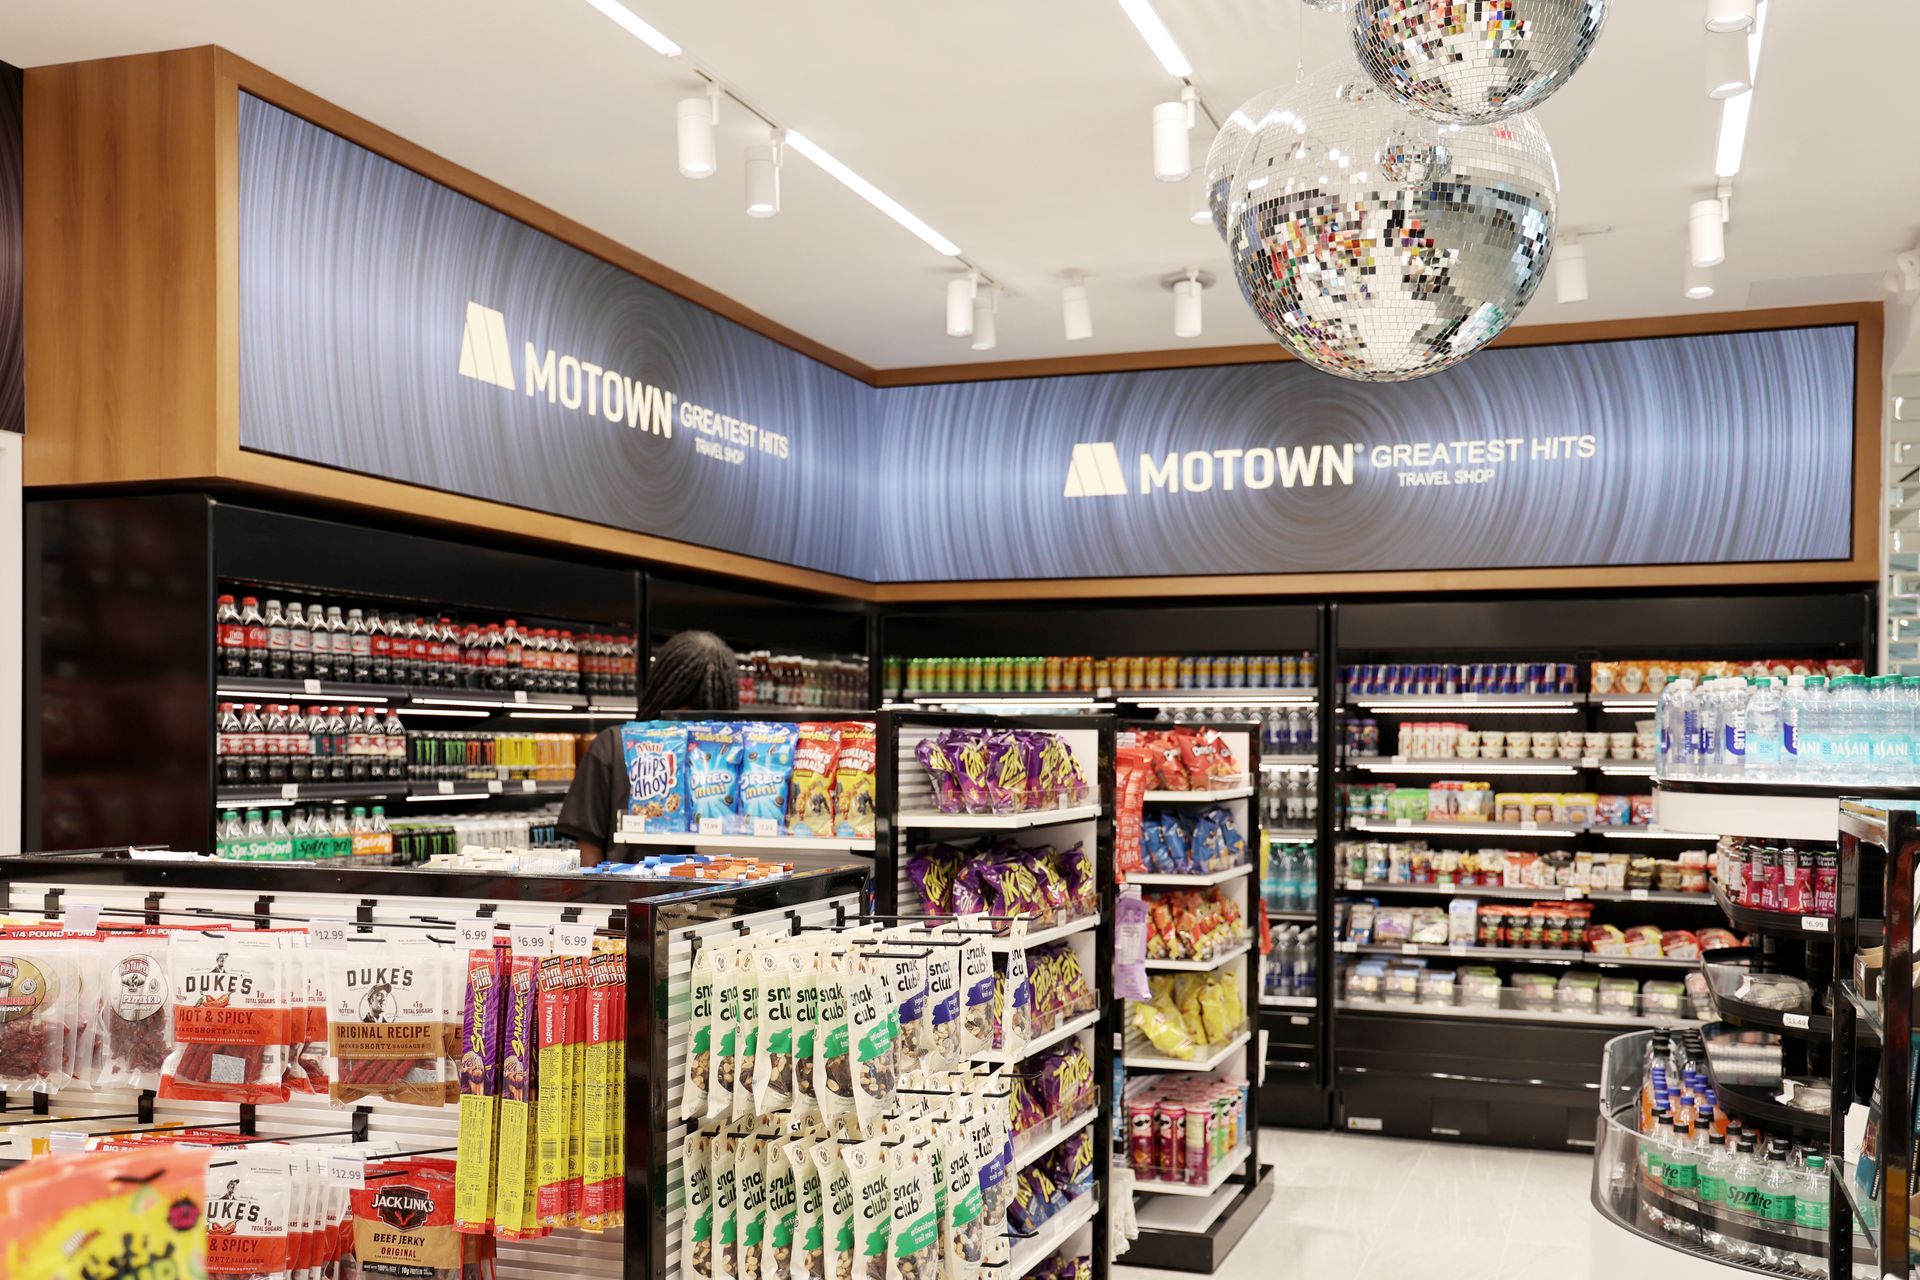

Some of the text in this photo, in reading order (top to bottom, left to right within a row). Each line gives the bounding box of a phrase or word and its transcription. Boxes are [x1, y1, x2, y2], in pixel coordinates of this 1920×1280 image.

[525, 341, 789, 460] MOTOWN GREATEST HITS
[1140, 434, 1597, 495] MOTOWN GREATEST HITS
[1397, 468, 1496, 488] TRAVEL SHOP
[630, 757, 666, 782] Chips
[694, 783, 726, 798] mini
[746, 784, 777, 799] mini
[11, 930, 27, 938] 1/4
[314, 930, 344, 940] $12.99
[461, 929, 487, 941] $6.99
[517, 936, 545, 947] $6.99
[560, 935, 587, 947] $6.99
[346, 965, 414, 988] DUKE'S
[186, 974, 254, 995] DUKE'S
[720, 985, 738, 1003] sna
[796, 986, 818, 1004] sna
[178, 1009, 254, 1025] HOT & SPICY
[545, 1005, 554, 1043] ORIGINAL
[592, 1002, 600, 1041] ORIGINAL
[194, 1026, 227, 1034] SHORTY
[387, 1025, 431, 1039] RECIPE
[360, 1042, 392, 1050] SHORTY
[102, 1144, 118, 1152] BIG
[331, 1168, 361, 1180] $12.99
[862, 1174, 889, 1201] snak
[893, 1176, 921, 1202] snak
[372, 1193, 402, 1210] JACK
[403, 1196, 435, 1213] LINK'S
[863, 1194, 888, 1219] club
[893, 1196, 919, 1220] club
[207, 1200, 261, 1222] UKE'S
[263, 1217, 272, 1226] 1g
[209, 1238, 259, 1253] & SPICY
[373, 1233, 426, 1247] BEEF JERKY
[380, 1246, 417, 1259] ORIGINAL
[377, 1264, 389, 1272] 100%
[401, 1267, 410, 1276] 10g
